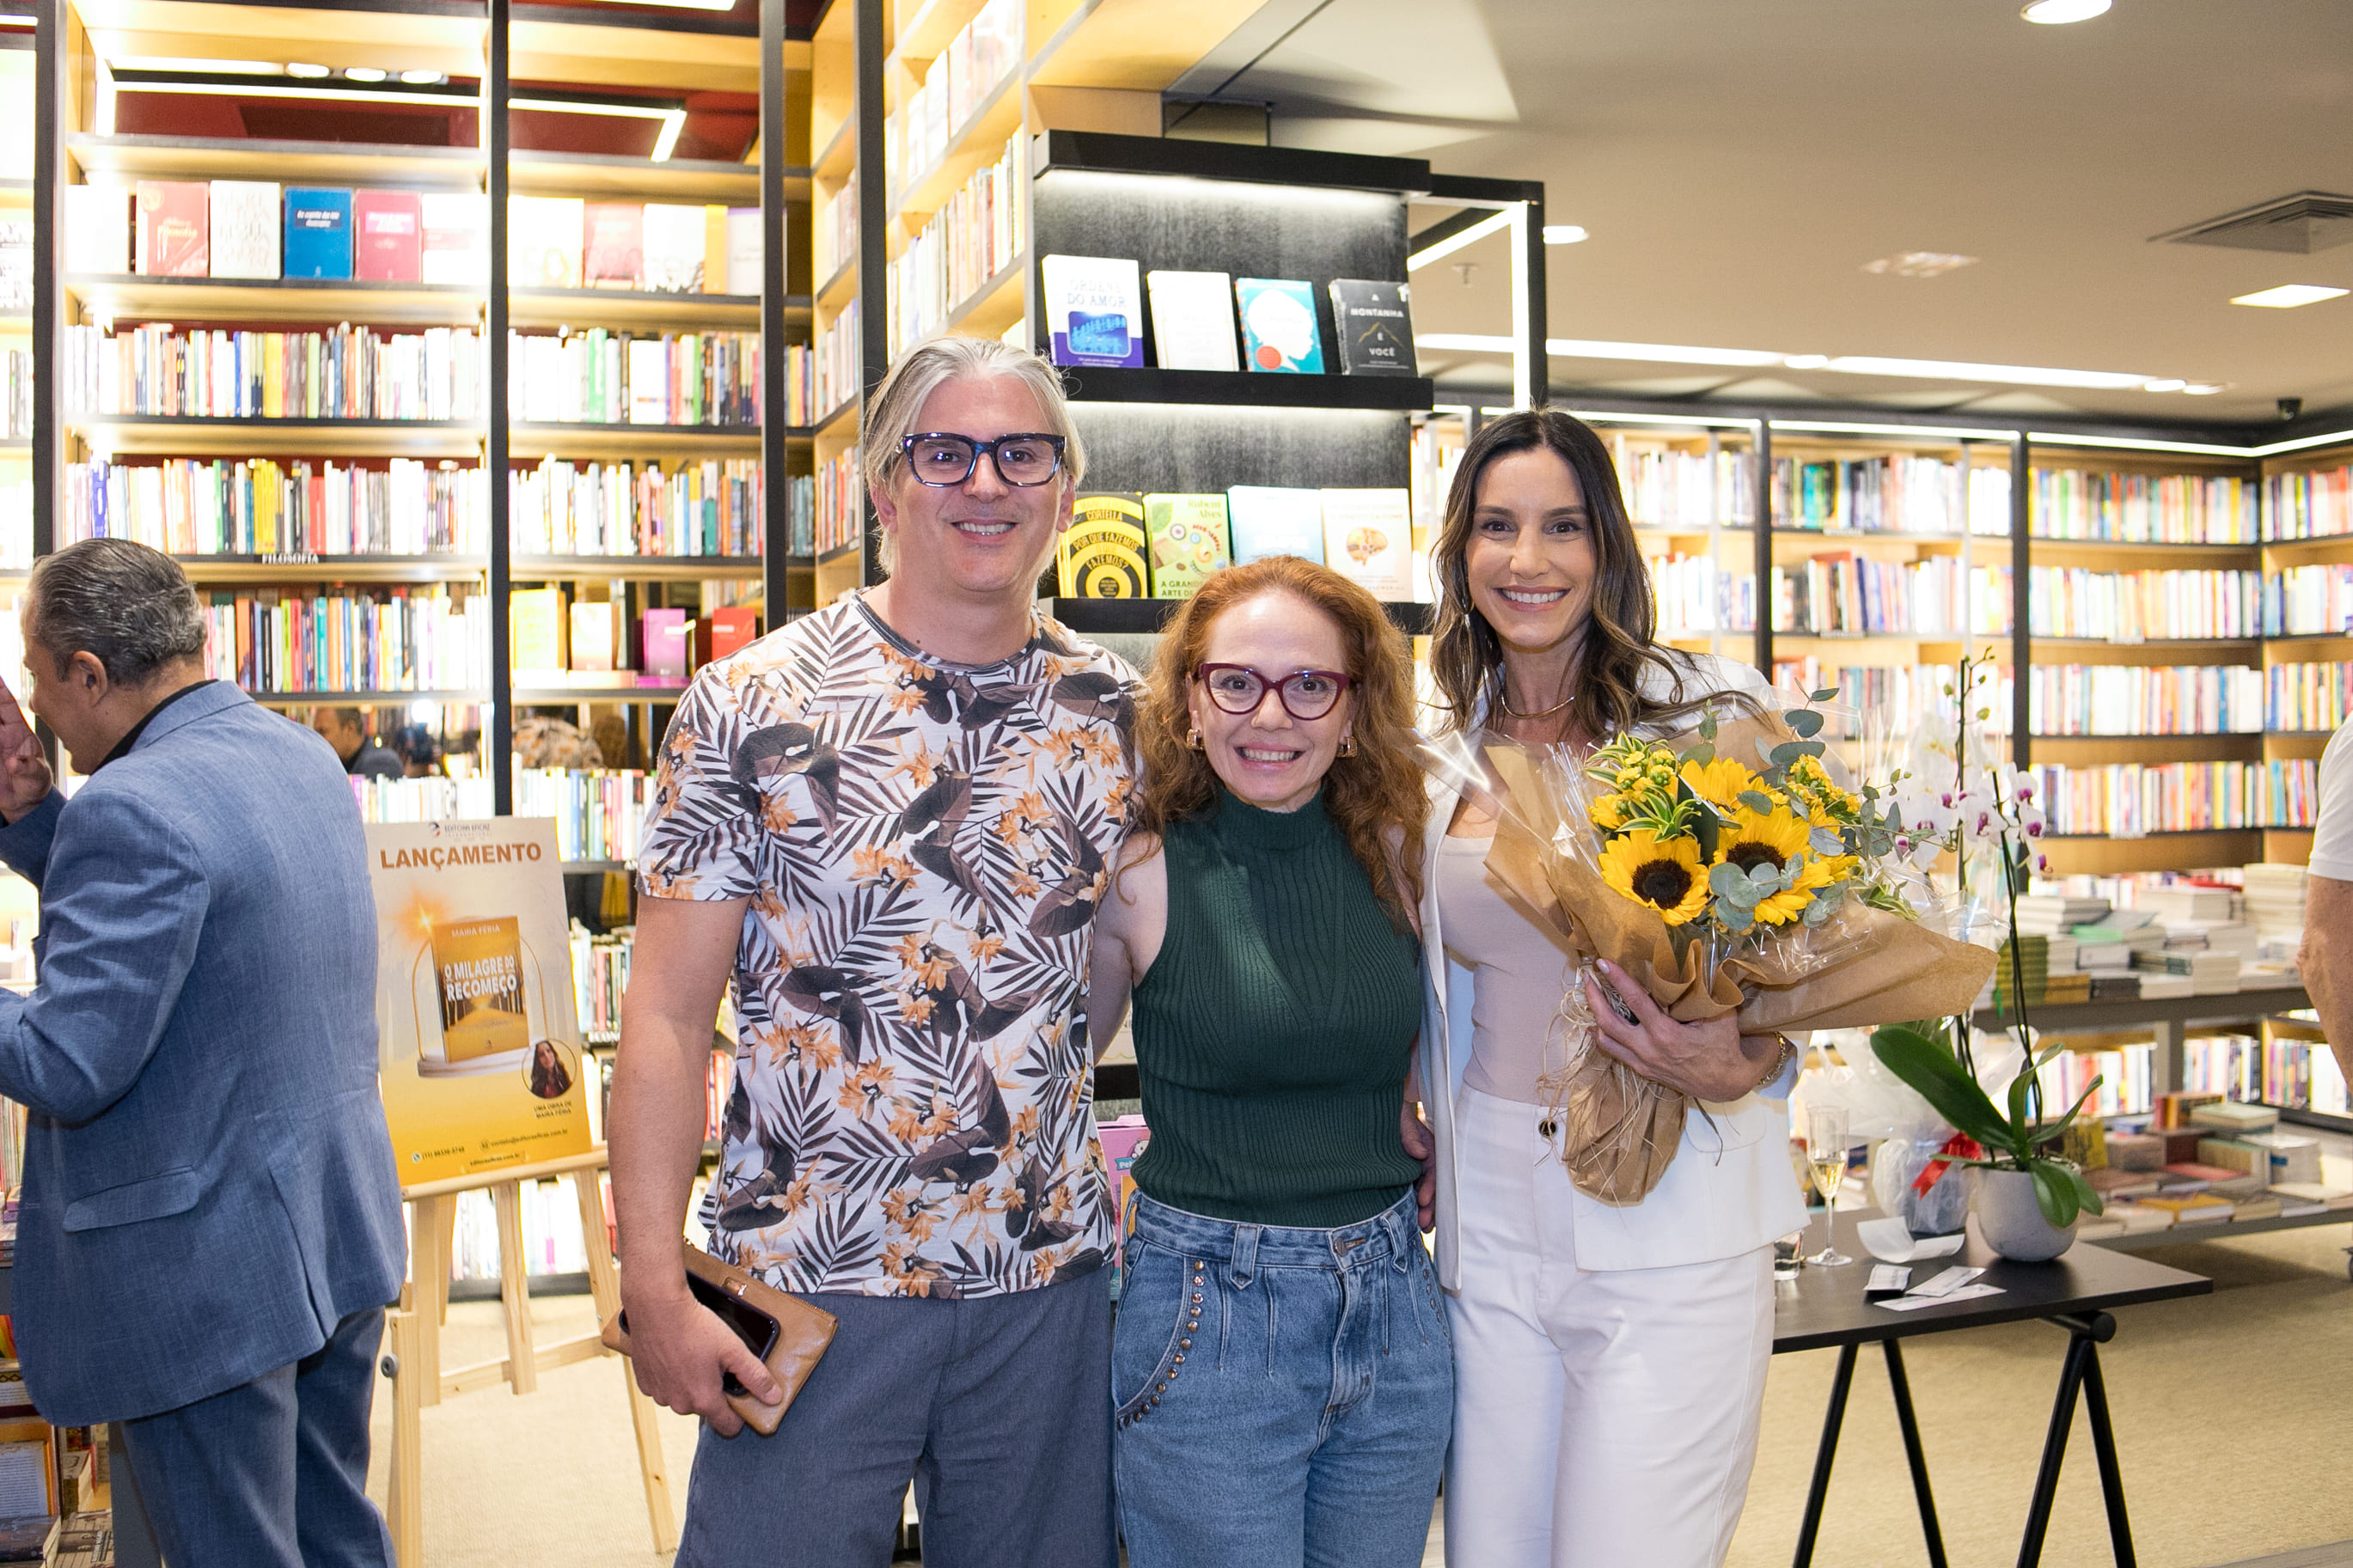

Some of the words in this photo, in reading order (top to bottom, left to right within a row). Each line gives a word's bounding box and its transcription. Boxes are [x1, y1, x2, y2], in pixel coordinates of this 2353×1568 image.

[1066, 292, 1085, 305] DO
[1089, 295, 1127, 308] AMOR
[1349, 308, 1405, 318] MONTANHA
[1188, 498, 1221, 509] Rubem
[1085, 509, 1123, 522] CORTELLA
[1200, 509, 1222, 519] Alves
[1073, 535, 1090, 552] POR
[1088, 532, 1105, 543] QUE
[1105, 532, 1140, 552] FAZEMOS
[261, 552, 320, 564] FILOSOFIA
[1085, 554, 1130, 570] FAZEMOS?
[380, 842, 542, 870] LANÇAMENTO
[444, 963, 452, 979] O
[453, 955, 504, 979] MILAGRE
[504, 955, 515, 969] DO
[446, 973, 517, 1002] RECOMEÇO
[588, 1030, 620, 1043] ECON
